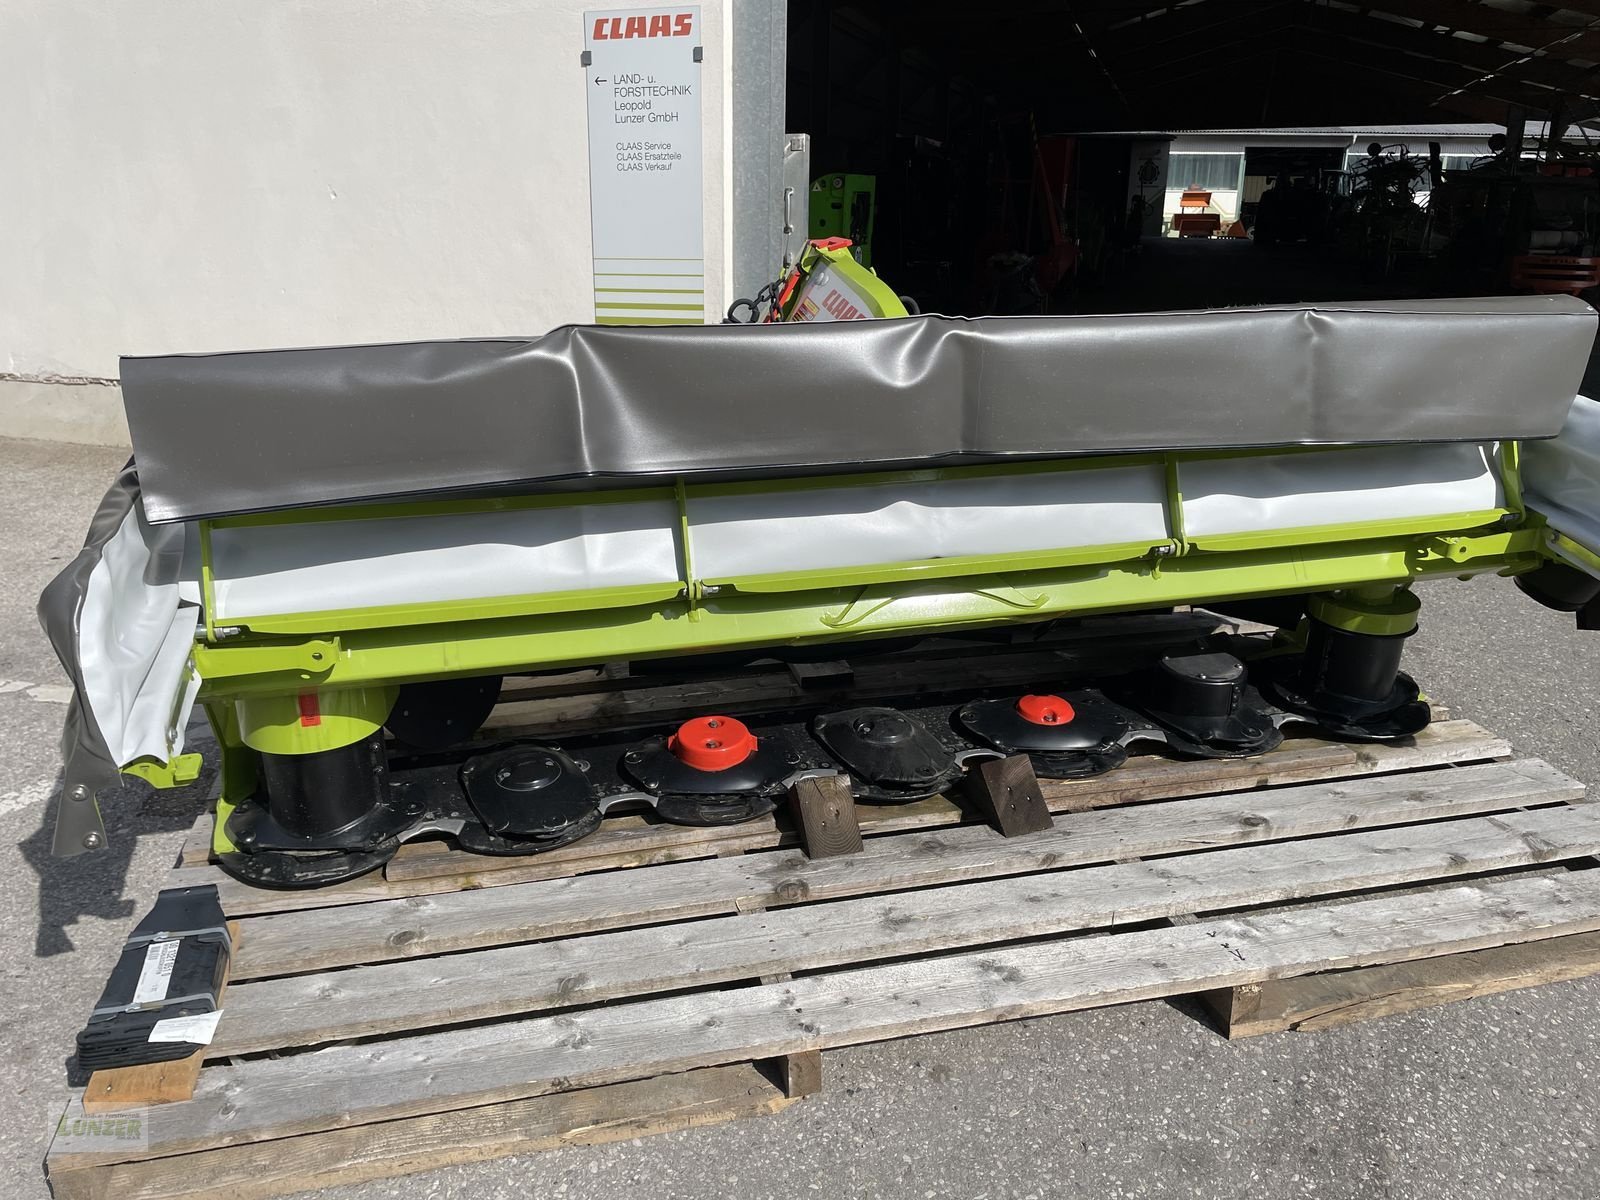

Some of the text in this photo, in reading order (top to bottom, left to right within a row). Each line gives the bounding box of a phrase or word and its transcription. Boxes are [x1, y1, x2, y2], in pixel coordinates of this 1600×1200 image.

[593, 13, 693, 40] CLAAS
[613, 74, 657, 84] LAND- u.
[613, 85, 693, 97] FORSTTECHNIK
[614, 100, 652, 112] Leopold
[614, 112, 679, 123] Lunzer GmbH
[615, 141, 672, 151] CLAAS Service
[616, 151, 682, 161] CLAAS Ersatzteile
[616, 162, 672, 171] CLAAS Verkauf
